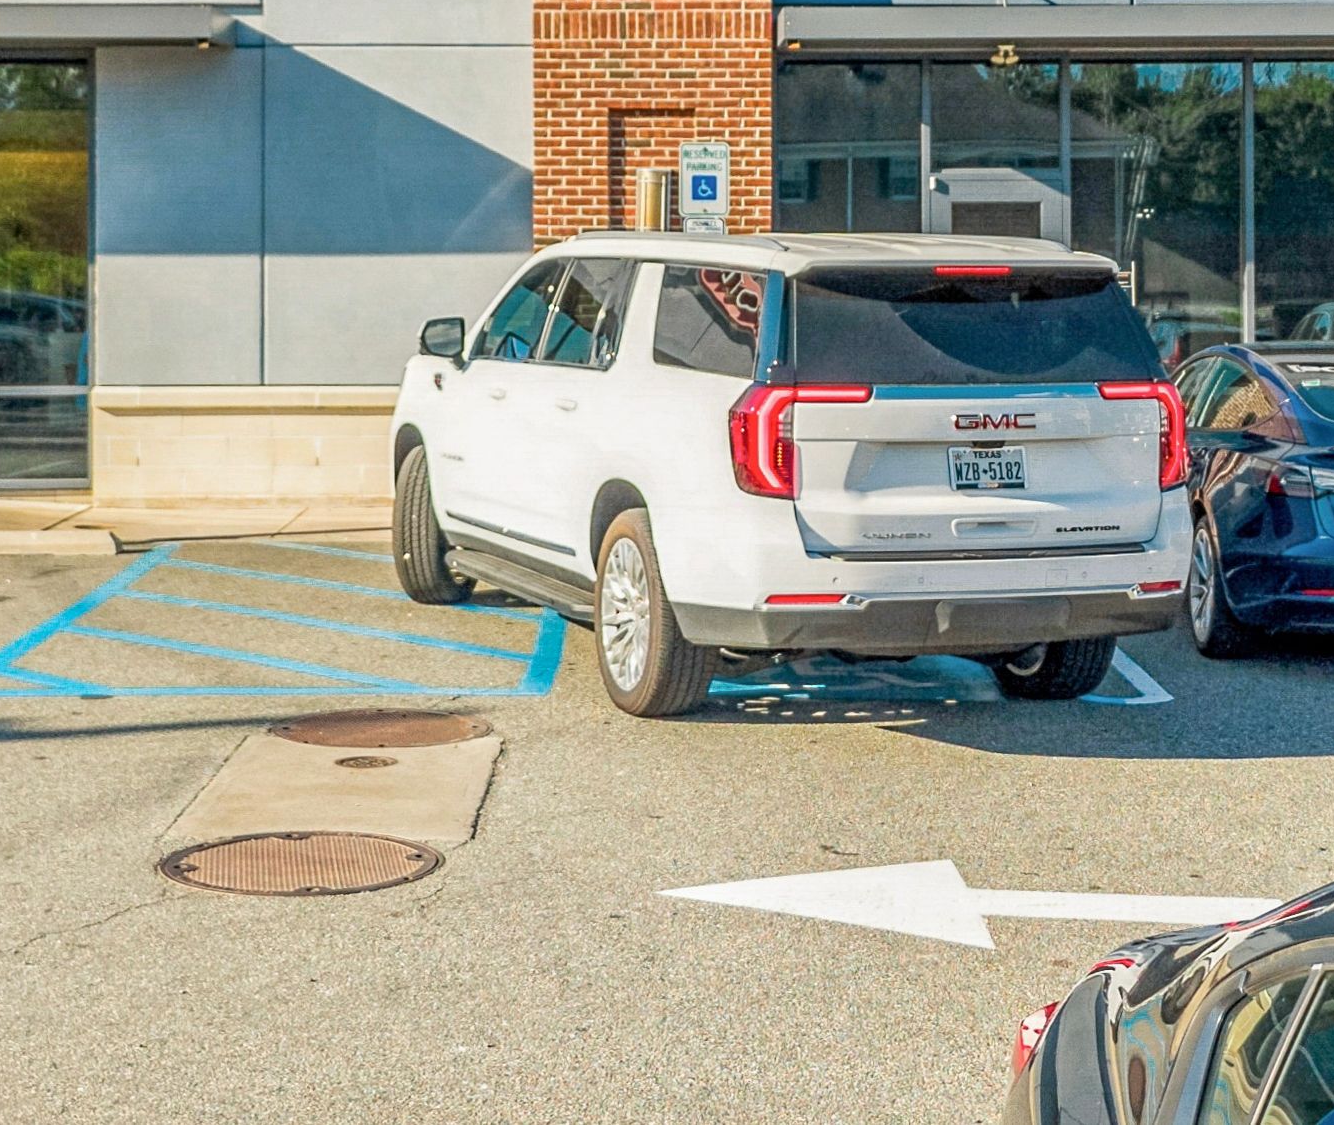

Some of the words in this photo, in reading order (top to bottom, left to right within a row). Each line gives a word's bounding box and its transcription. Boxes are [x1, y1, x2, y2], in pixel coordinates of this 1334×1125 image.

[683, 149, 727, 159] RESERVED
[686, 162, 723, 171] PARKING
[954, 413, 1036, 429] GMC
[973, 450, 1002, 459] TEXAS
[1055, 525, 1121, 533] ELEVATION
